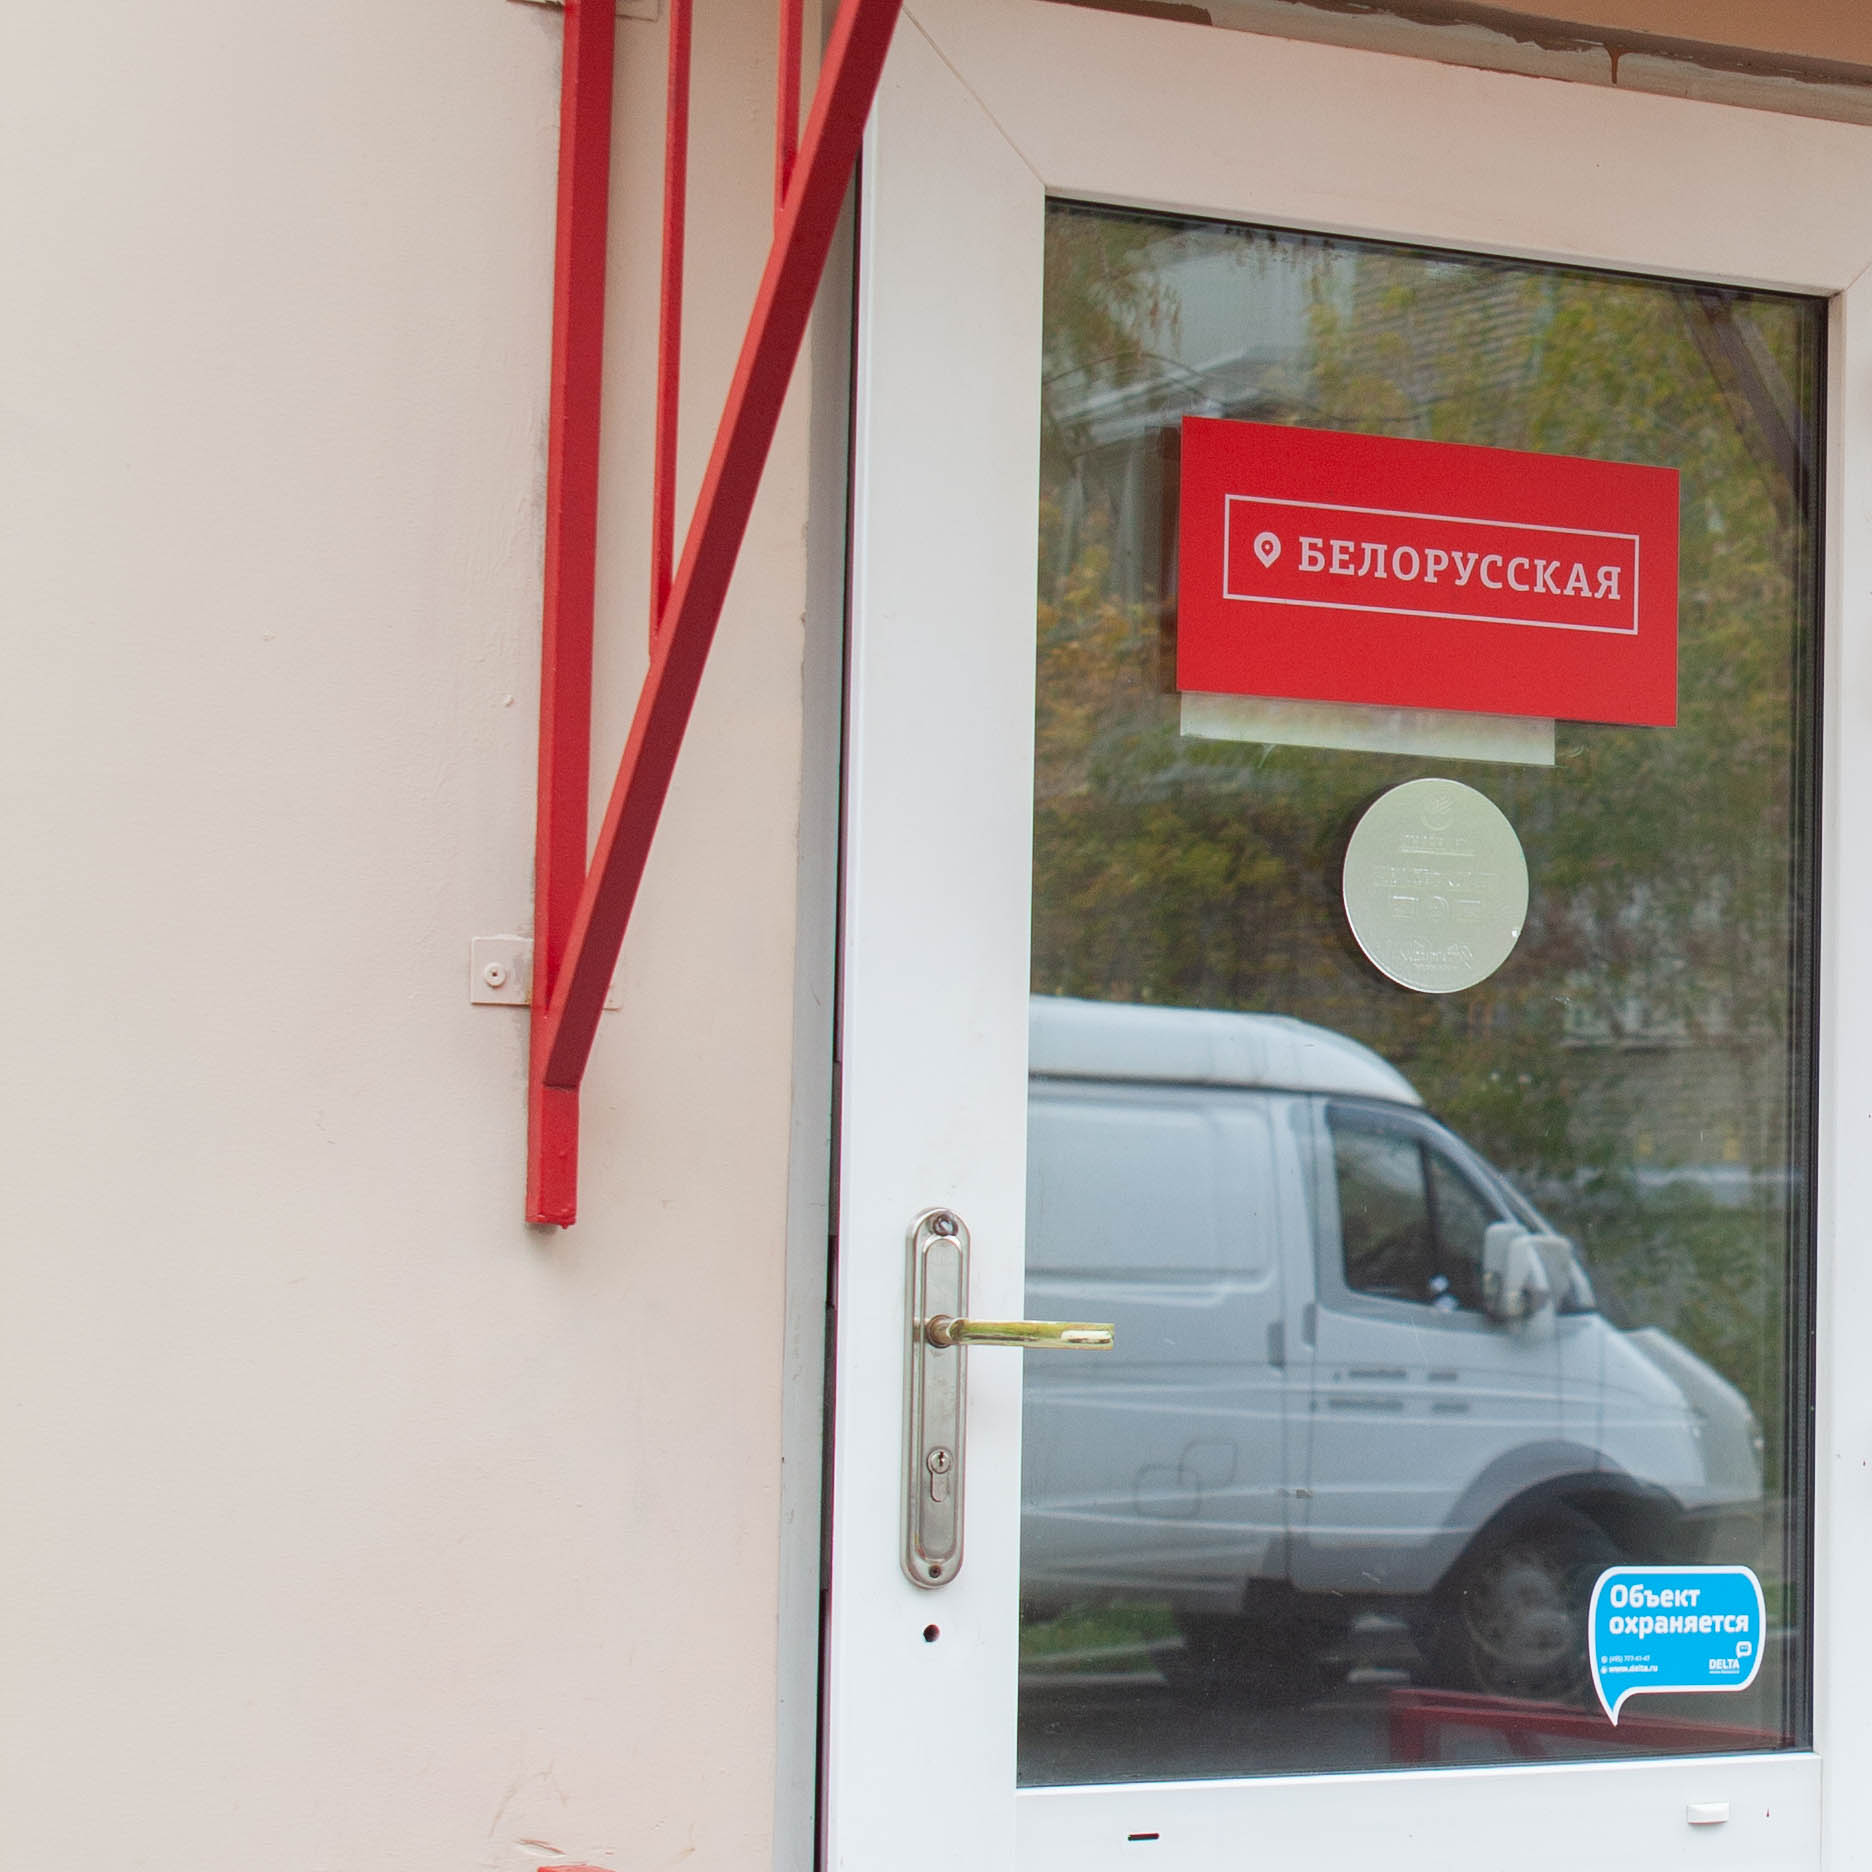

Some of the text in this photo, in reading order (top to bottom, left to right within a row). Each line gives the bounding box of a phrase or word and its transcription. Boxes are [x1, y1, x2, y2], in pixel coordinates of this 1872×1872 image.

[1299, 536, 1621, 600] БЕЛОРУССКАЯ
[1610, 1584, 1700, 1608] Объект
[1609, 1615, 1749, 1639] охраняется
[1709, 1658, 1740, 1669] DELTA
